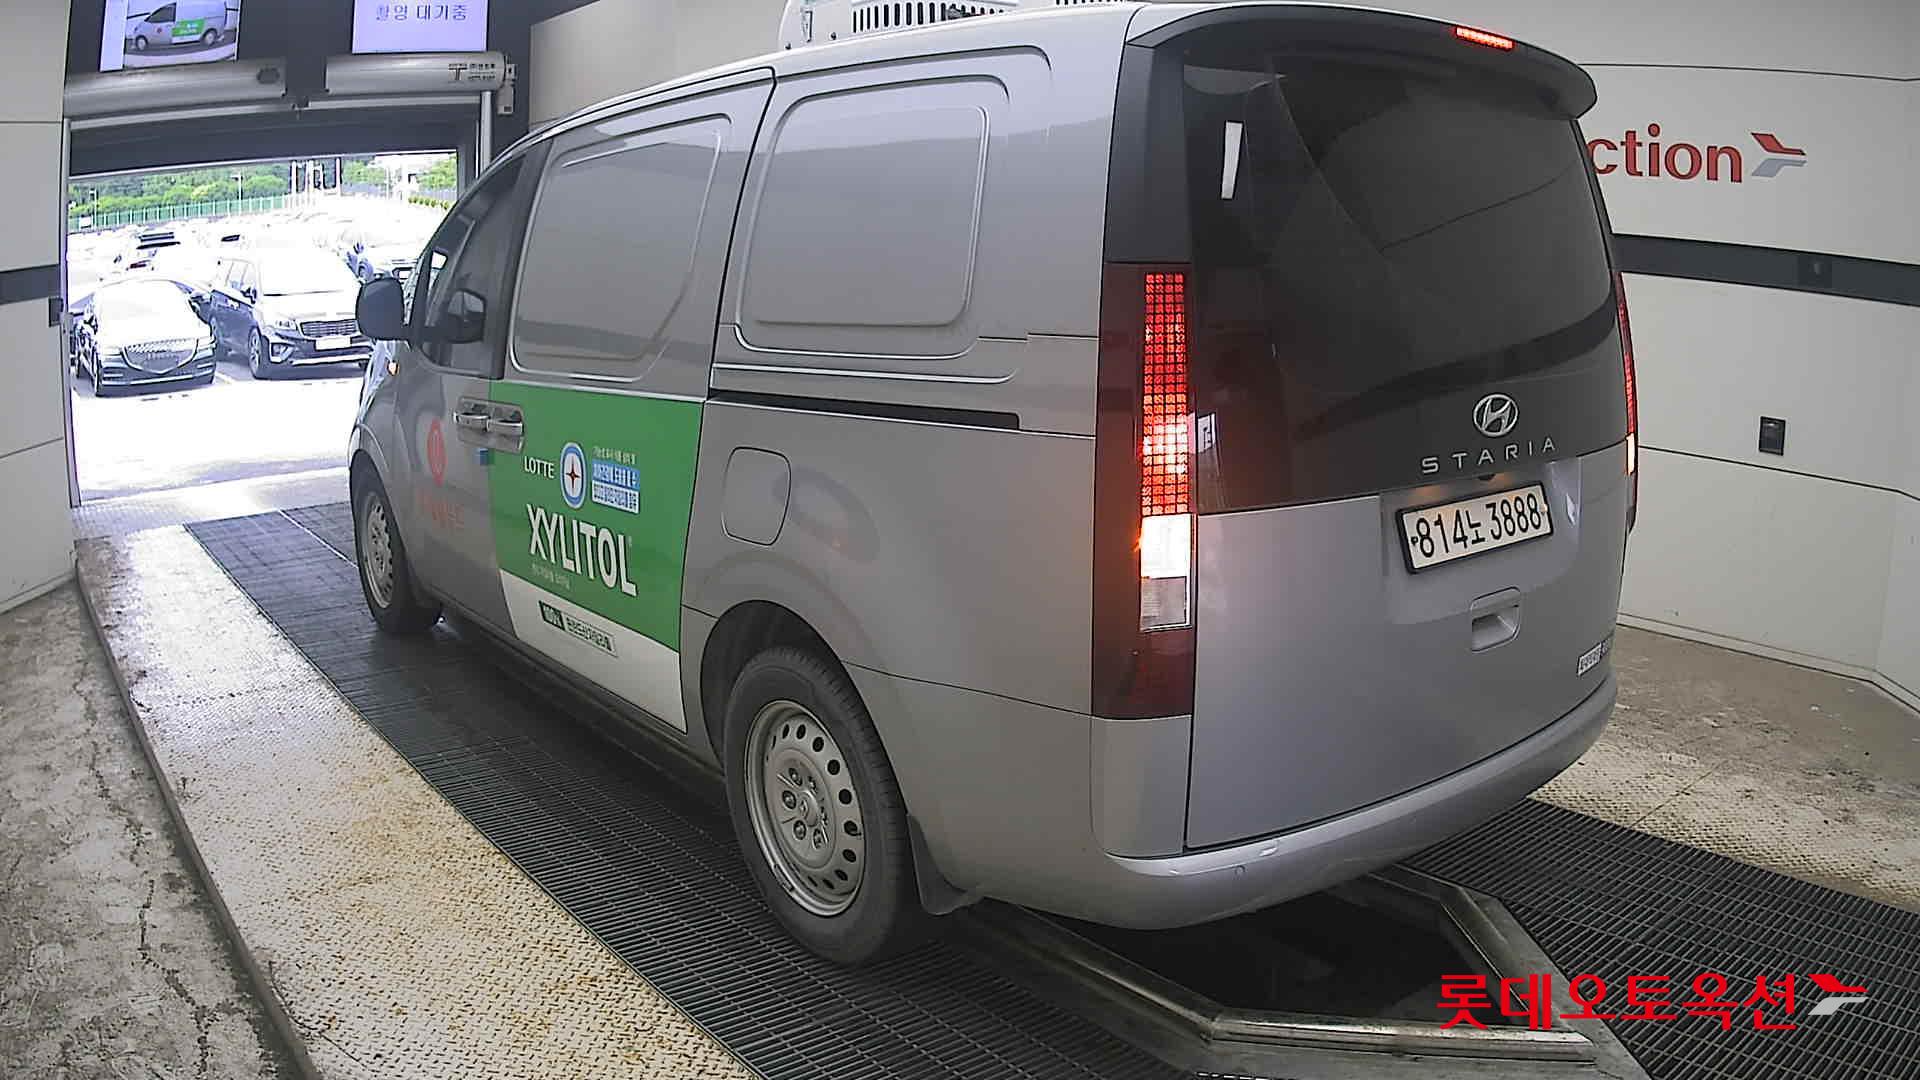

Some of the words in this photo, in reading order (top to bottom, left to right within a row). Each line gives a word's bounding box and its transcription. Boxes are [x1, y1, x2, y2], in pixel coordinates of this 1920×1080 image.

[416, 4, 467, 21] 대기중
[1587, 122, 1743, 184] ction
[524, 455, 555, 479] LOTTE
[1421, 437, 1556, 474] STARIA
[526, 503, 638, 597] XYLITOL
